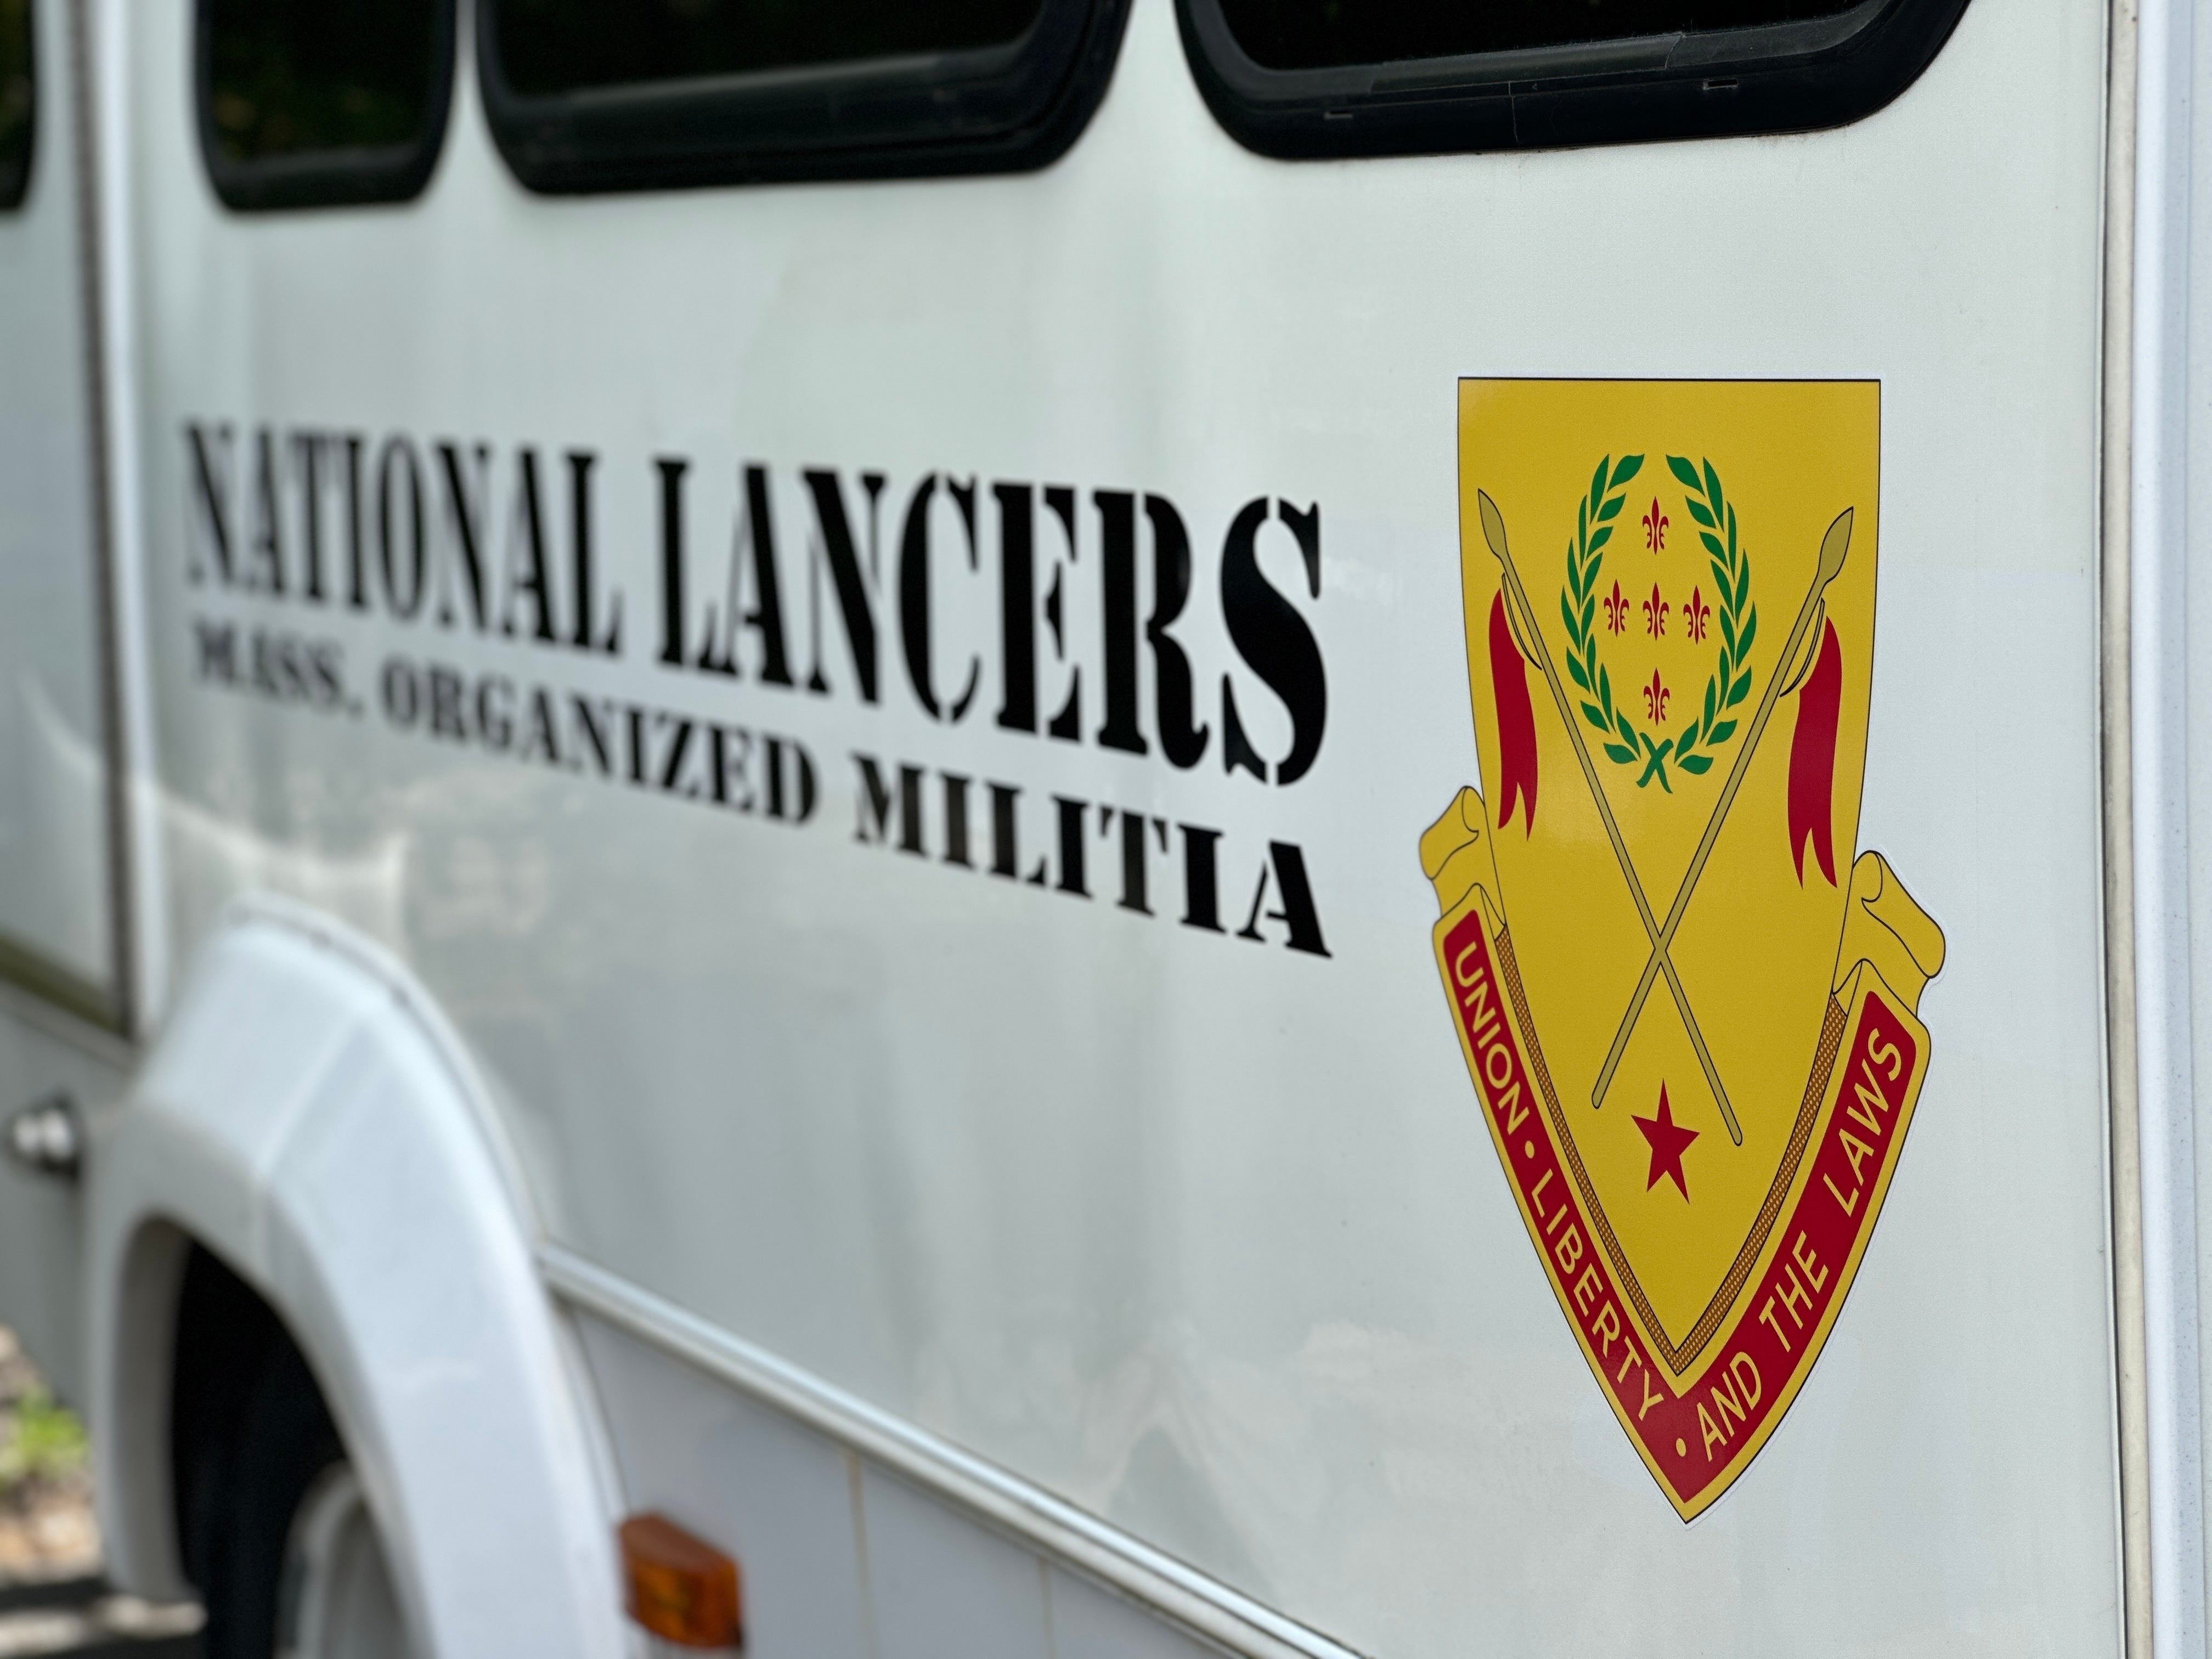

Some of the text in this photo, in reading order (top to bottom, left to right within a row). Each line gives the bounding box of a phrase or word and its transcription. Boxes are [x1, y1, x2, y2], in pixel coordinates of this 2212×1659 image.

[184, 421, 1328, 787] NATIONAL LANCERS
[195, 620, 1333, 959] MASS. ORGANIZED MILITIA
[1455, 941, 1902, 1462] UNION LIBERTY AND THE LAWS
